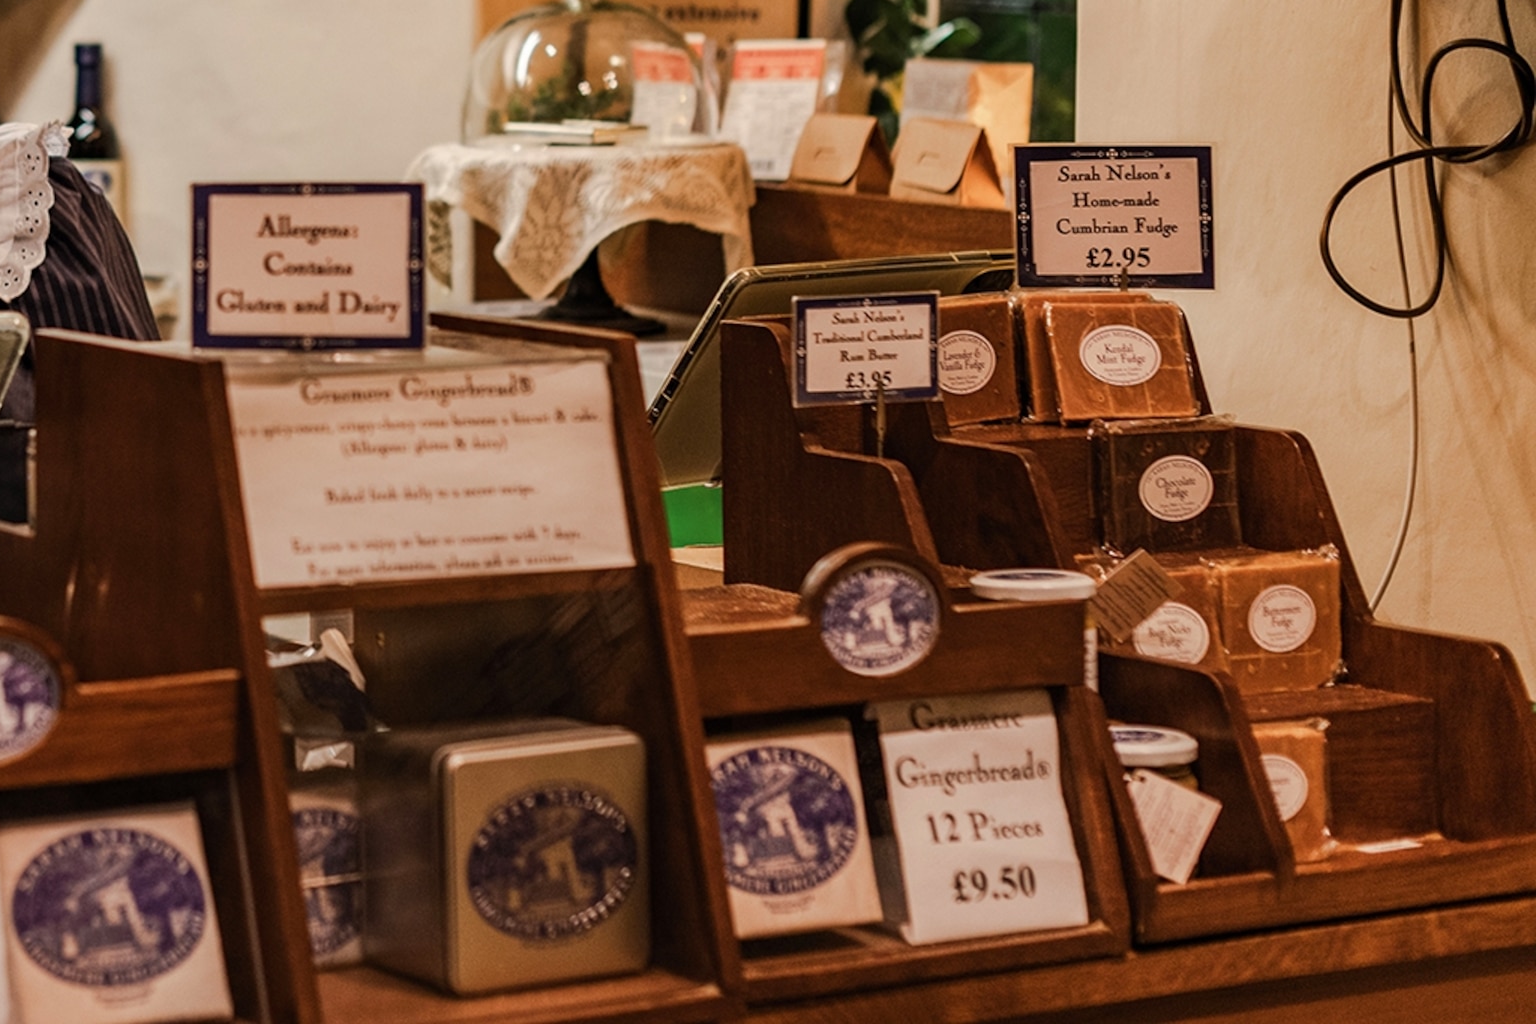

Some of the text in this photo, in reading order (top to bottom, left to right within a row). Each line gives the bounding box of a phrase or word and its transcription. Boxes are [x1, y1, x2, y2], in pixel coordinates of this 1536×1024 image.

[1057, 163, 1171, 182] Sarah Nelson's
[1072, 191, 1160, 208] Home-made
[1056, 216, 1179, 238] Cumbrian Fudge
[262, 250, 354, 277] Contains
[1086, 247, 1151, 268] £2.95
[216, 288, 401, 323] Gluten and Dairy
[832, 309, 905, 325] Sarah Nelson's
[812, 328, 924, 345] Traditional Cumberland
[840, 348, 898, 363] Rum Butter
[845, 370, 892, 389] £3.95
[908, 701, 1024, 732] Grasmere
[927, 811, 1044, 844] 12 Pieces
[952, 864, 1036, 903] £9.50
